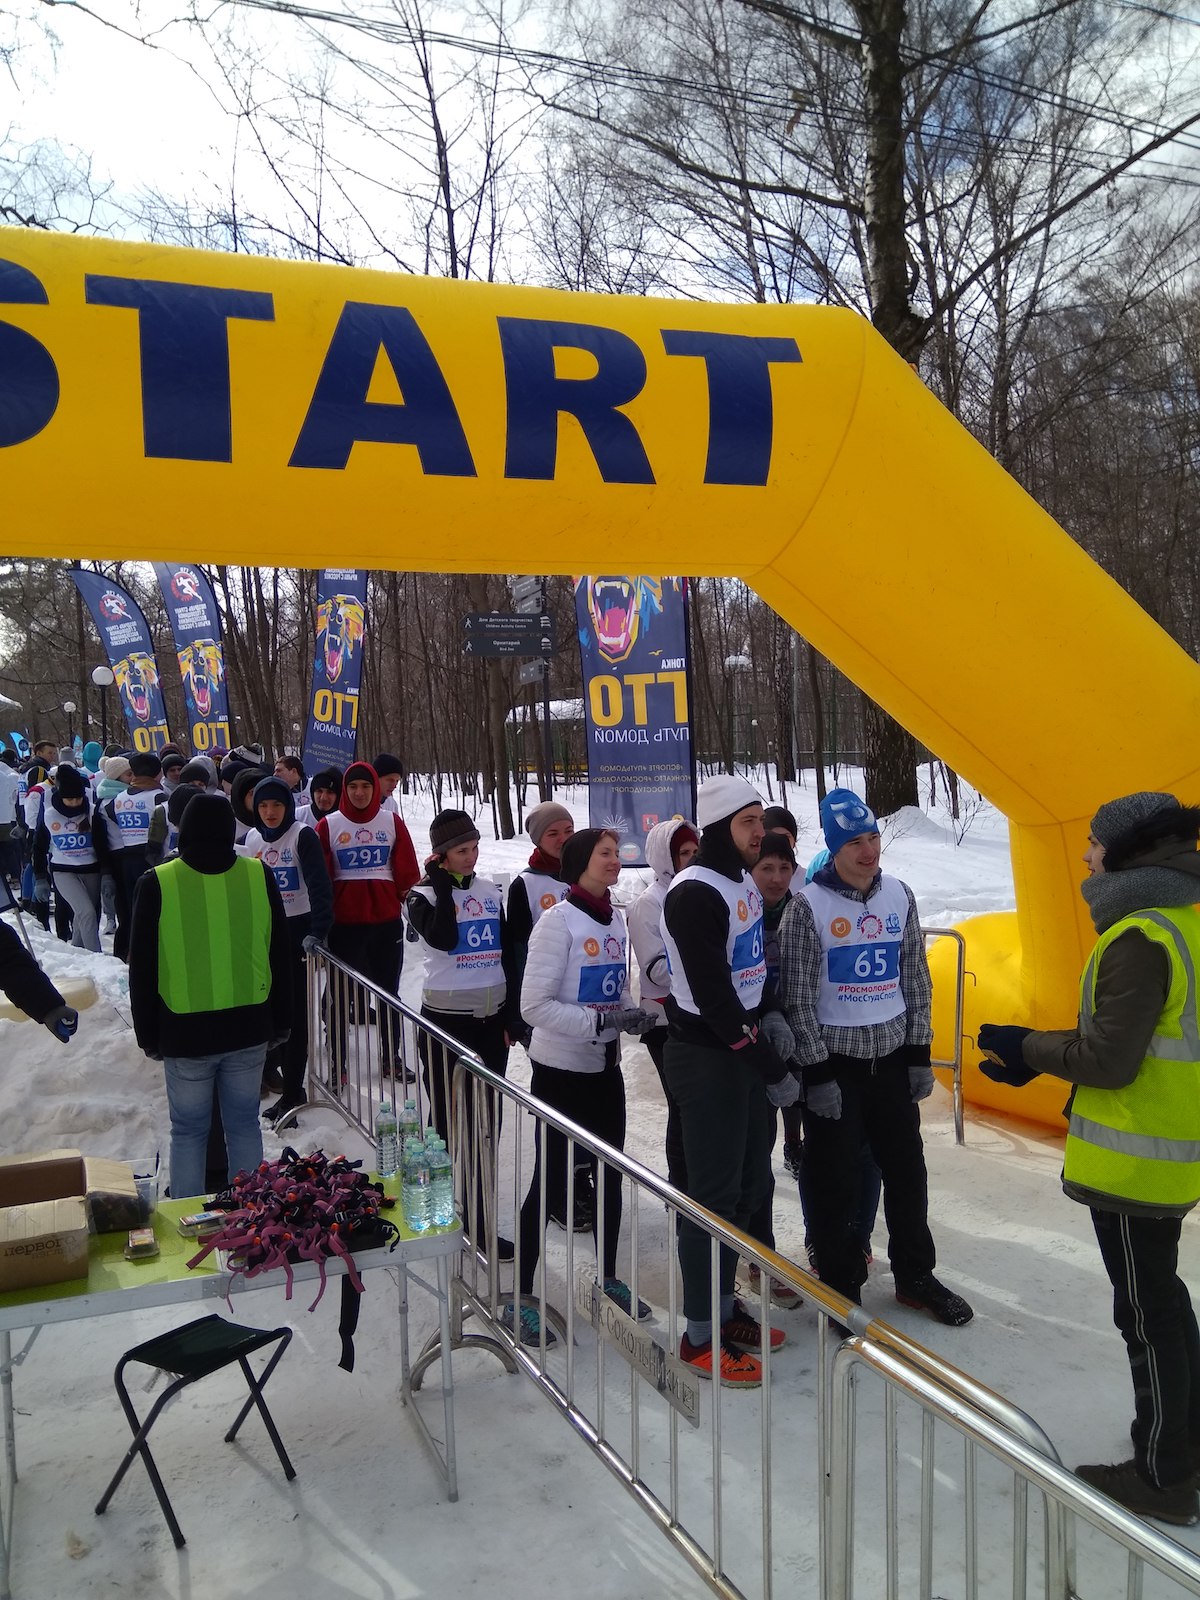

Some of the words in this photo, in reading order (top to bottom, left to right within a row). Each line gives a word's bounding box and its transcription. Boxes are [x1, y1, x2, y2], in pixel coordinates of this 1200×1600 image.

[120, 814, 141, 826] 335
[58, 835, 86, 848] 290
[347, 848, 382, 867] 291
[273, 870, 289, 888] 3
[467, 923, 494, 948] 64
[854, 949, 887, 978] 65
[602, 970, 625, 996] 68
[838, 991, 897, 1003] #МосСтудСпорт
[578, 1278, 604, 1328] Парк
[606, 1306, 680, 1400] Сокольники
